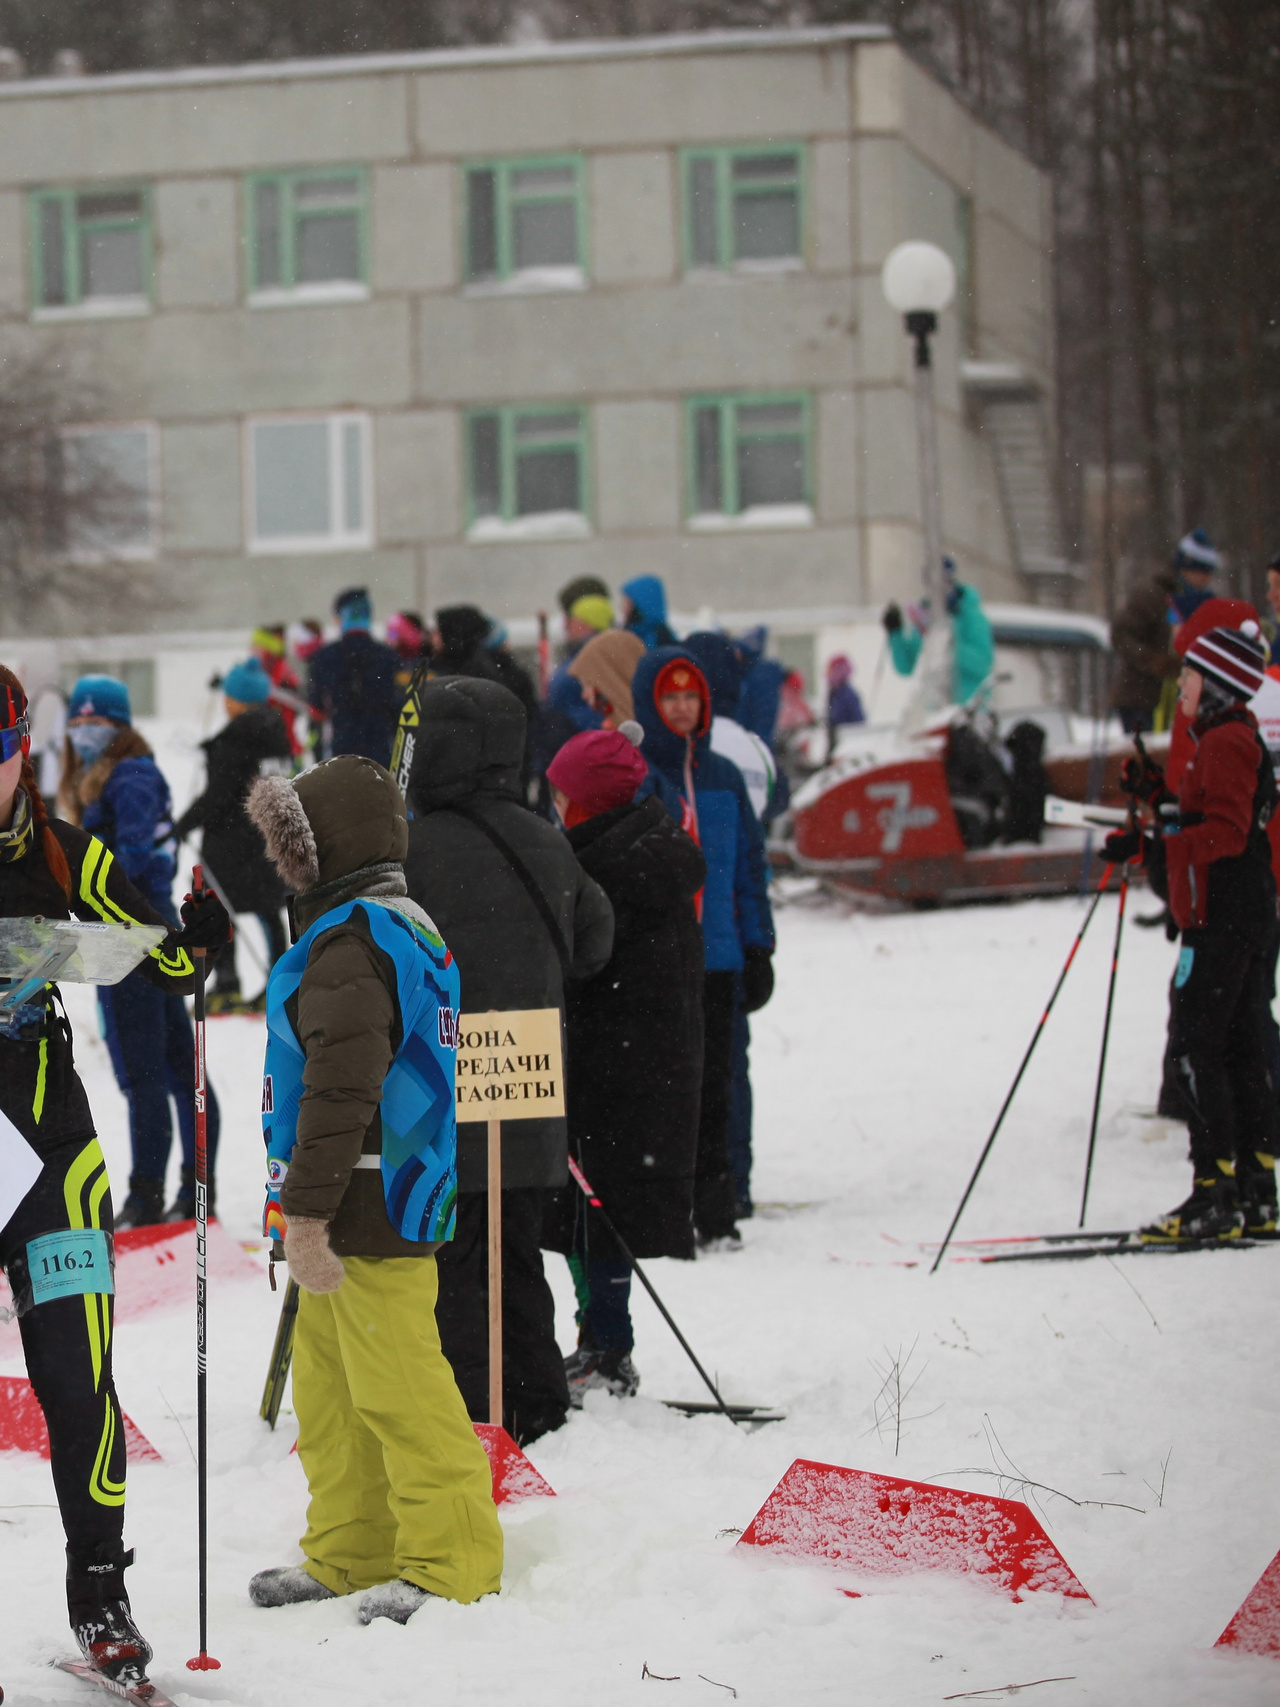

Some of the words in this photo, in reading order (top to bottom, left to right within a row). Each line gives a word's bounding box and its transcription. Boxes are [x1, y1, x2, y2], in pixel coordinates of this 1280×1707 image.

[399, 732, 417, 800] SCHER
[456, 1054, 551, 1078] РЕДАЧИ
[455, 1081, 556, 1103] ТАФЕТЫ
[196, 1184, 207, 1277] SPORT
[41, 1249, 95, 1276] 116.2
[87, 1563, 114, 1573] alpina
